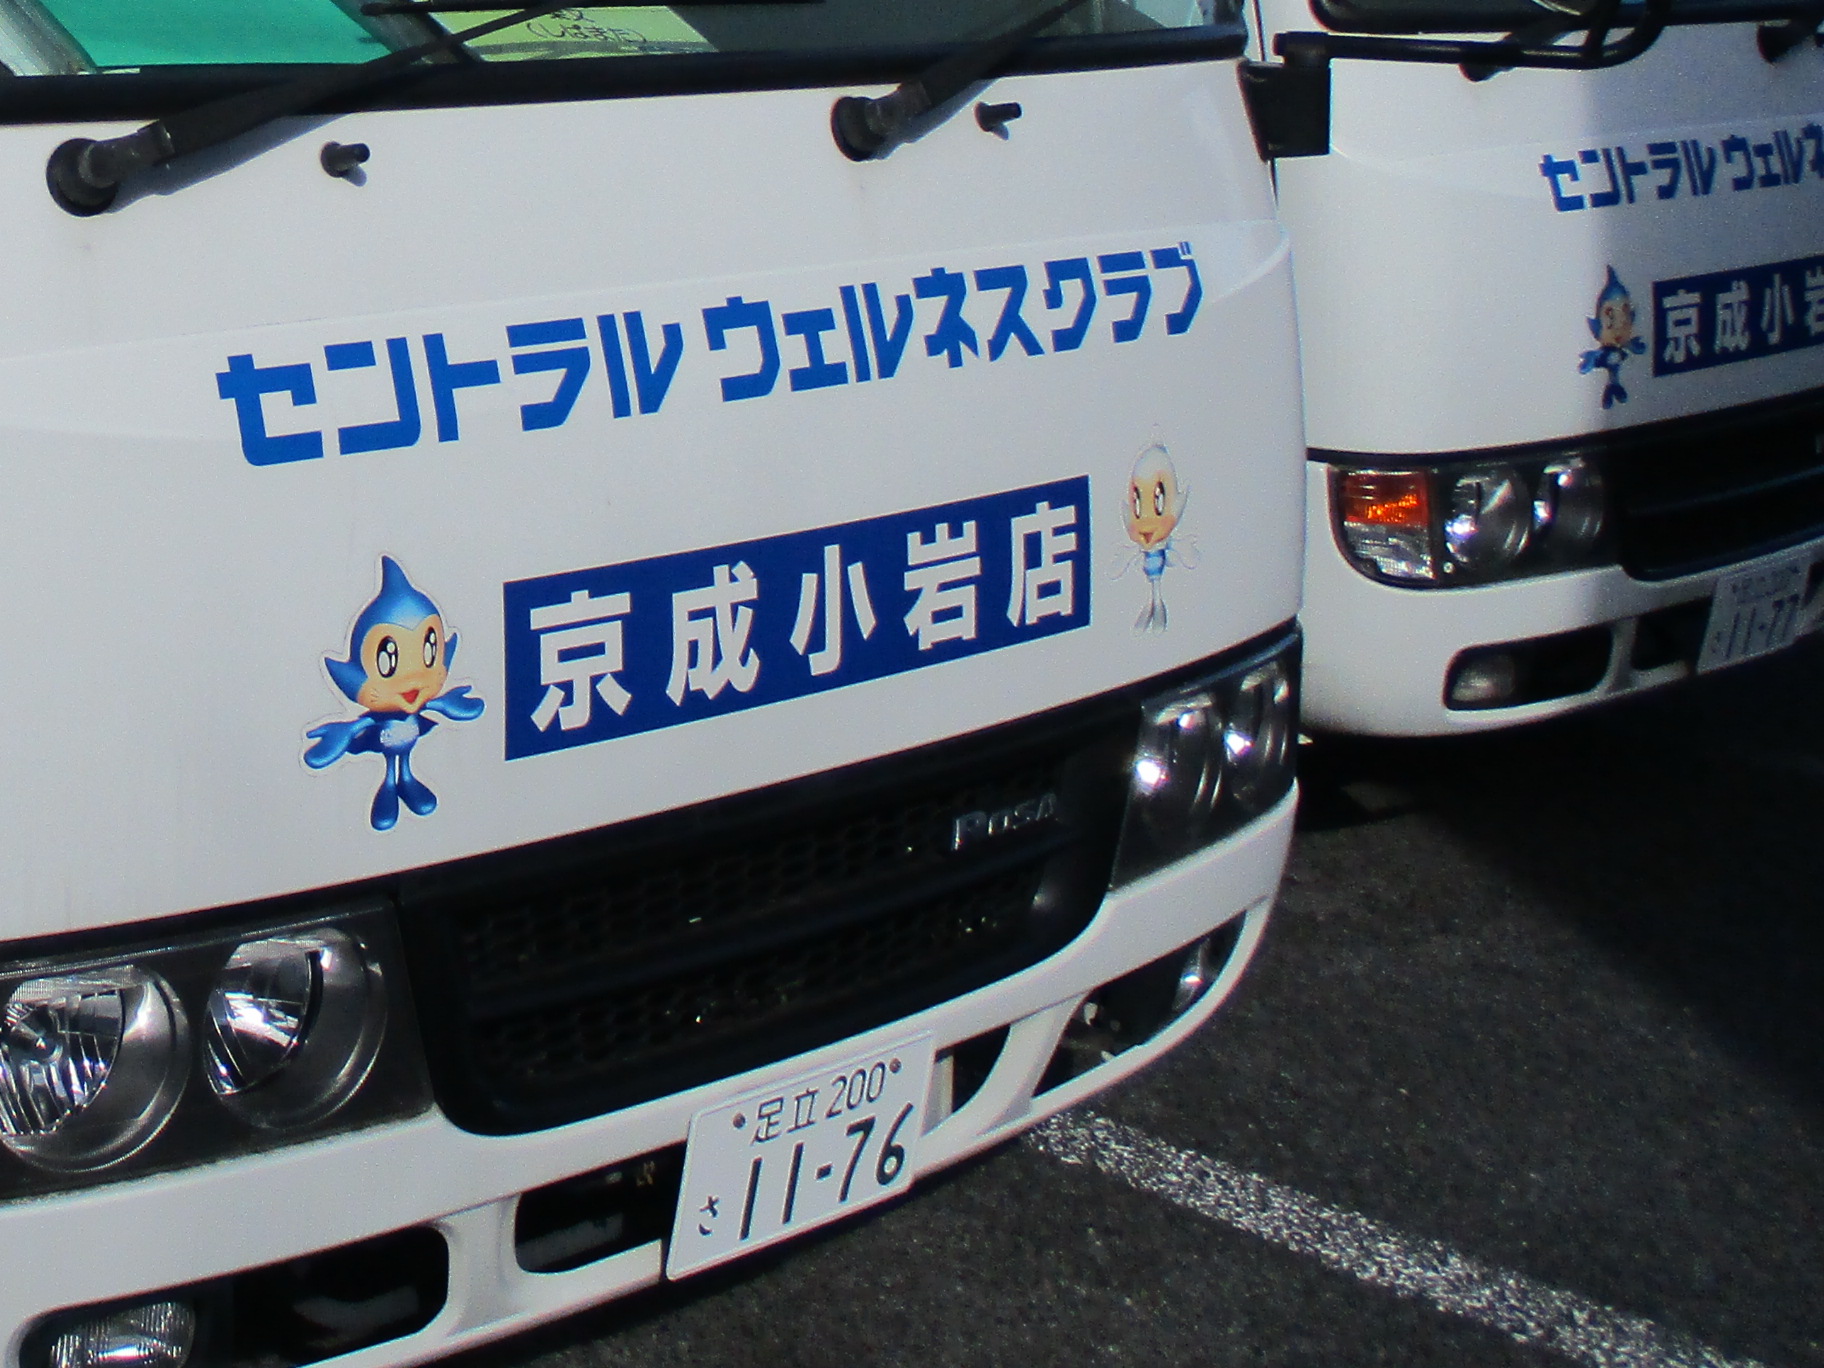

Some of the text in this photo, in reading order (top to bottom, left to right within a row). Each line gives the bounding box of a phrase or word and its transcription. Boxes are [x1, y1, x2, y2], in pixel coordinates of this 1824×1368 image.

[529, 500, 1080, 735] 京成小岩店
[698, 1102, 914, 1241] さ 11-76
[750, 1061, 887, 1144] 足立 200
